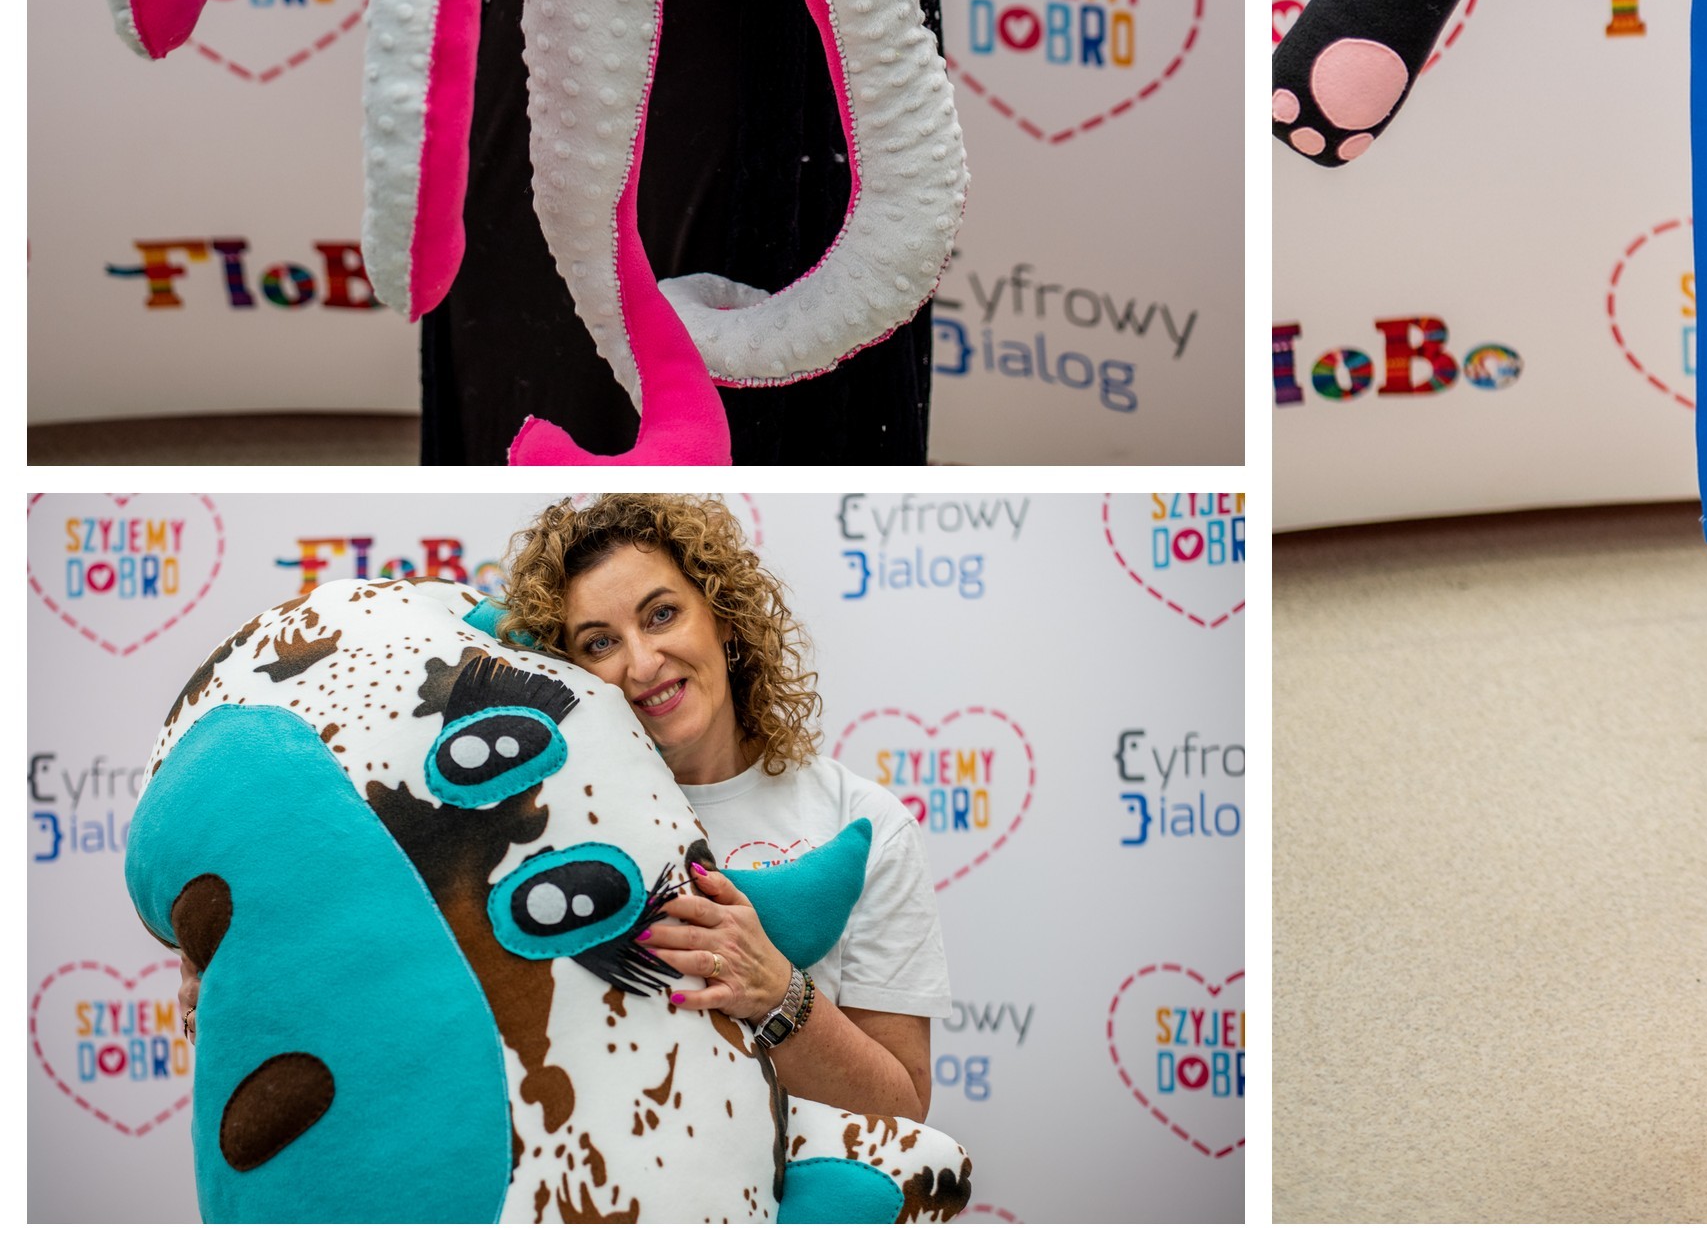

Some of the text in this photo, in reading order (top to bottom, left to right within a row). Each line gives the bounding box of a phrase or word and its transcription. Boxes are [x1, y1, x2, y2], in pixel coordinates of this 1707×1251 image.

[932, 318, 1140, 414] Dialog
[65, 517, 184, 554] SZYJEMY
[836, 493, 1028, 541] Cyfrowy
[66, 555, 179, 599] DOBRO
[842, 549, 984, 601] Dialog
[876, 748, 995, 787] SZYJEMY
[899, 787, 991, 833] OBRO
[1120, 791, 1241, 847] Dialo
[75, 999, 177, 1038] SZYJEM
[77, 1038, 190, 1083] DOBRO
